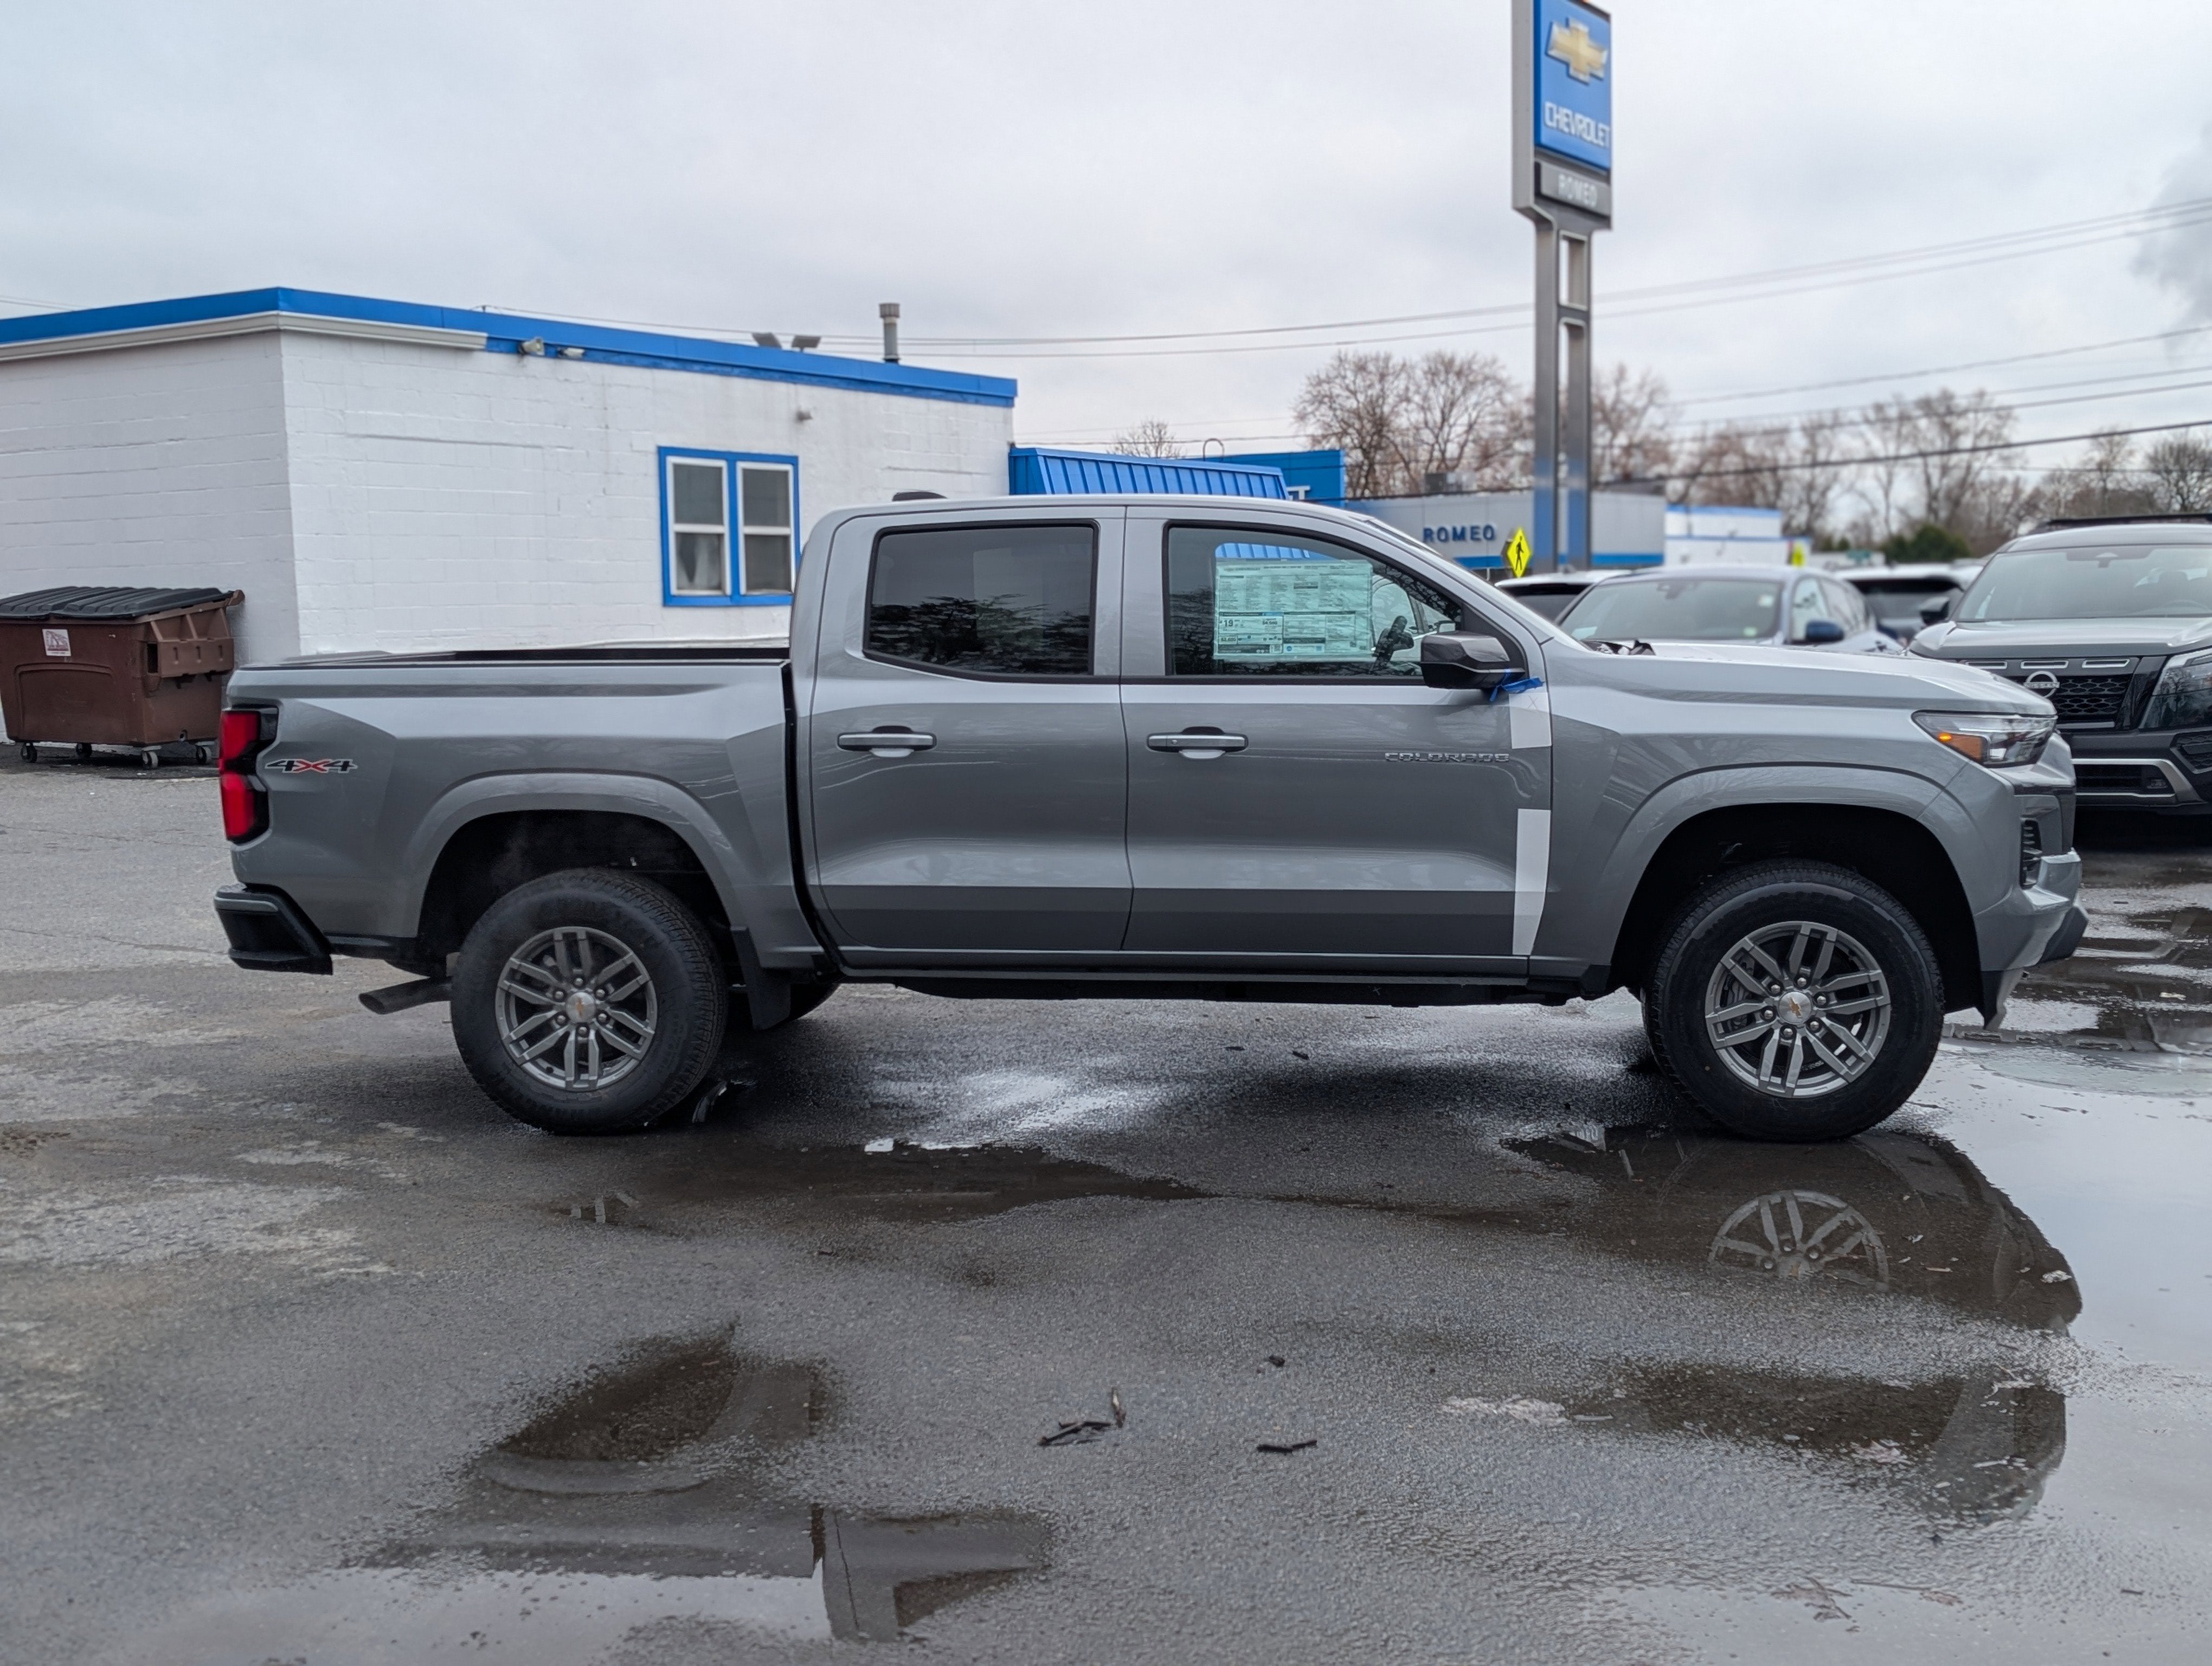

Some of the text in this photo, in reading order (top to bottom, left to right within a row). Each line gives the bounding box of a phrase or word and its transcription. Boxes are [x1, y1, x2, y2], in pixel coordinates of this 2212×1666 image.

[1544, 100, 1610, 149] CHEVROLET
[1558, 173, 1598, 208] ROMEO
[1423, 524, 1495, 543] ROMEO
[1224, 619, 1233, 627] 19
[1384, 752, 1510, 762] COLORADO
